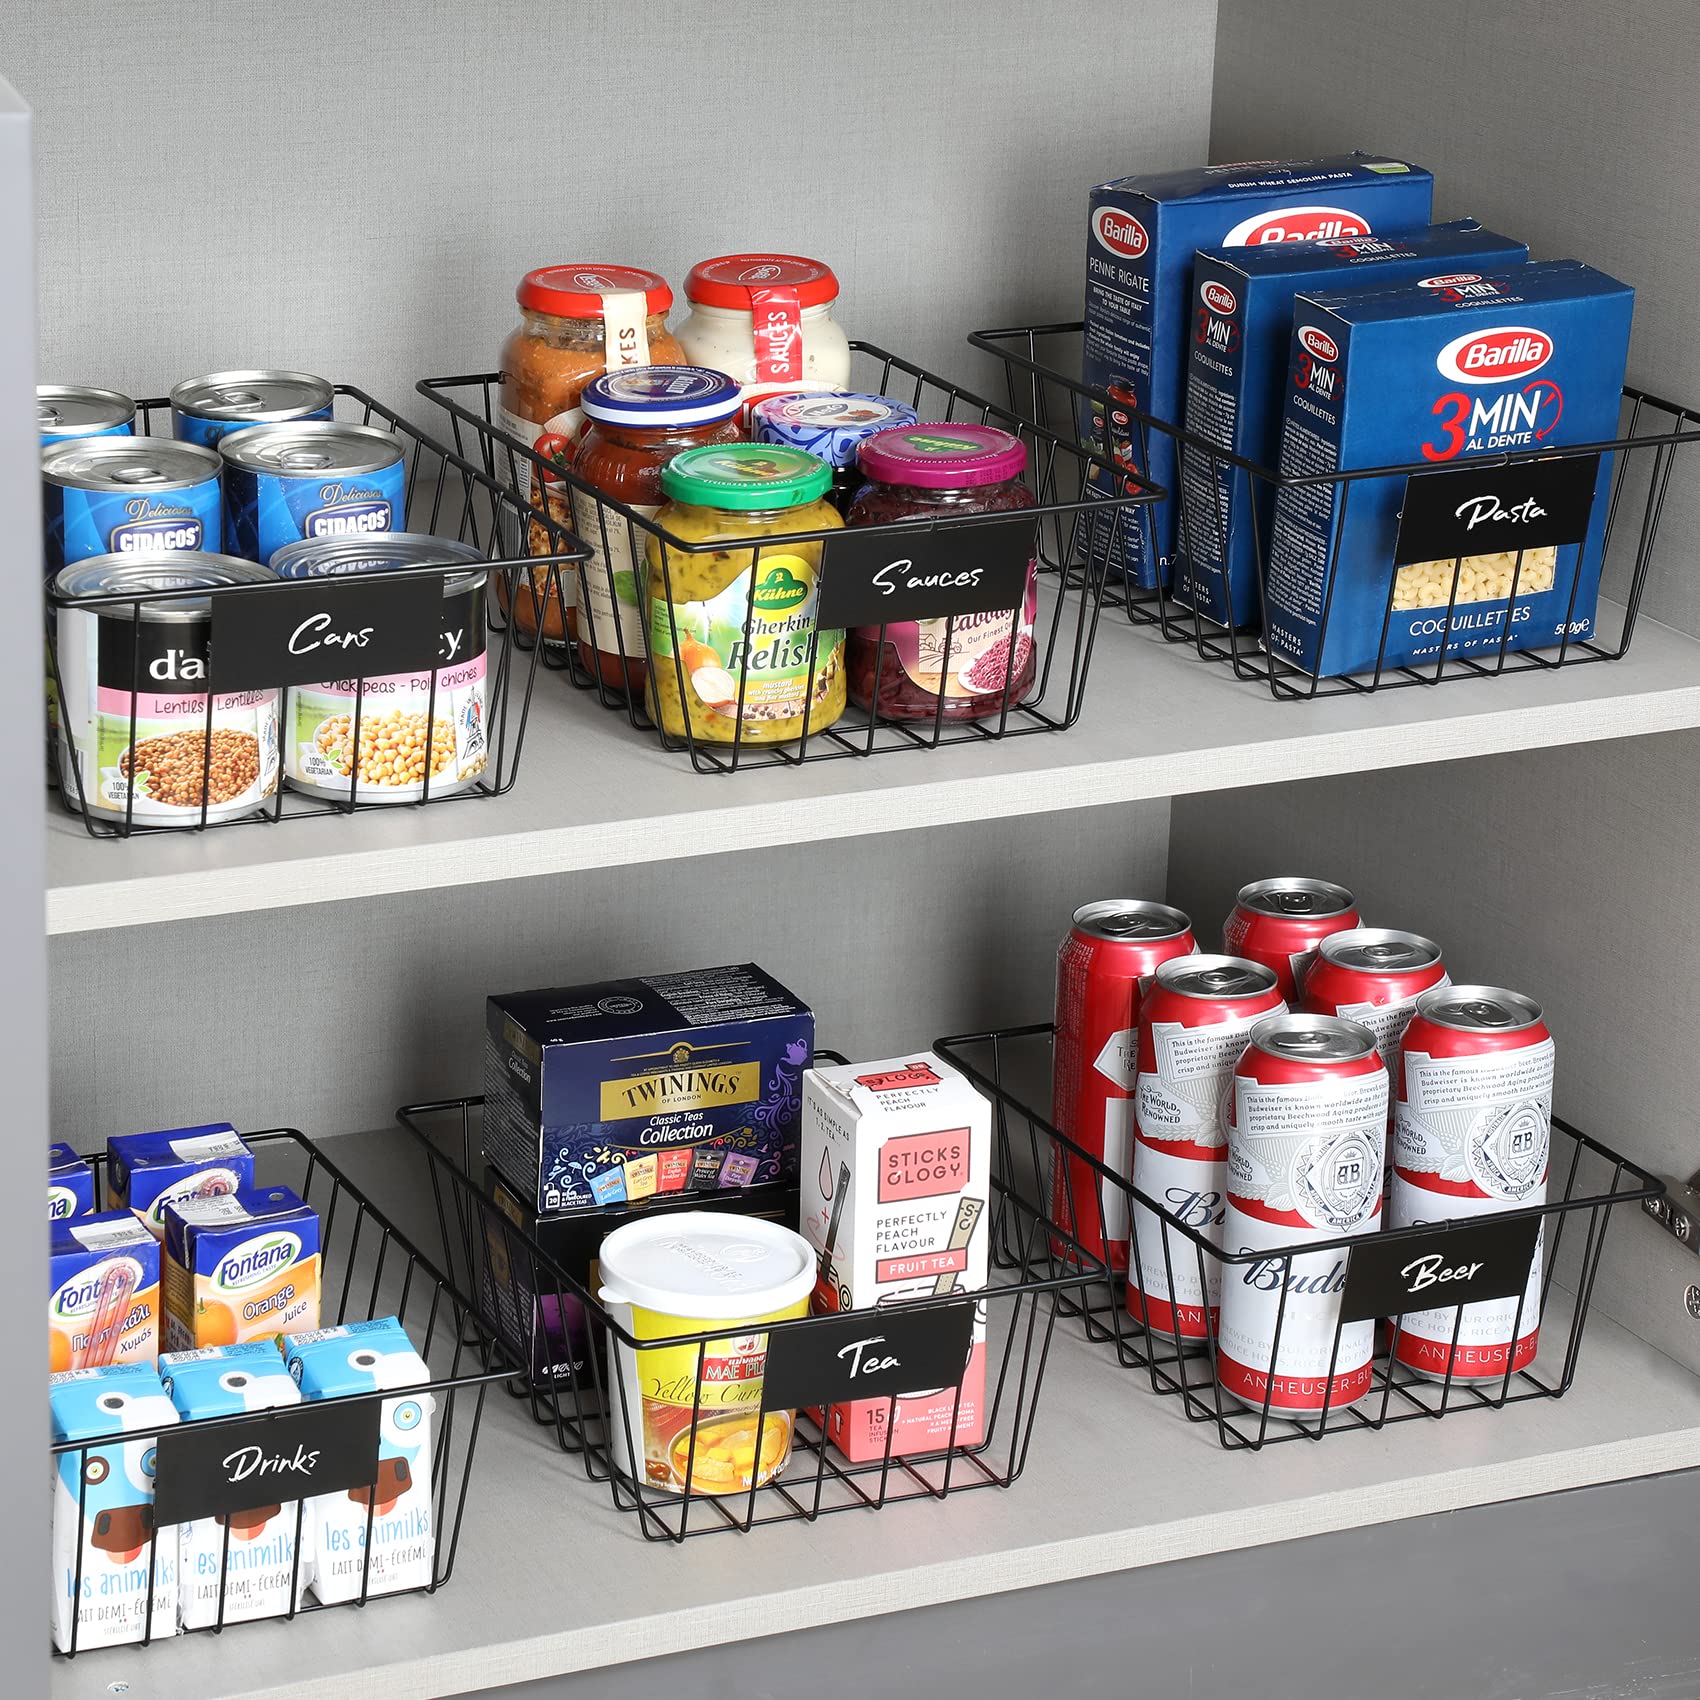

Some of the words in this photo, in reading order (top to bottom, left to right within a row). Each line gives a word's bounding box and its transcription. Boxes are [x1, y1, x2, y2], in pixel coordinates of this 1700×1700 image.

[1228, 181, 1256, 189] DURUM
[1258, 179, 1285, 187] WHEAT
[1287, 175, 1327, 185] SEMOLINA
[1328, 172, 1353, 180] PASTA
[1103, 217, 1143, 249] Barilla
[1350, 242, 1391, 252] MIN
[1089, 257, 1115, 280] PENNE
[1118, 268, 1149, 293] RIGATE
[1208, 288, 1232, 309] Barilla
[1453, 283, 1498, 295] MIN
[1455, 296, 1524, 309] COQUILLETTES
[1195, 307, 1211, 345] 3
[1207, 316, 1231, 345] MIN
[768, 310, 790, 374] SAUCES
[1307, 334, 1335, 357] Barilla
[1194, 350, 1233, 377] COQUILLETTES
[1464, 337, 1544, 369] Barilla
[1295, 352, 1313, 389] 3
[1310, 362, 1336, 392] MIN
[1293, 394, 1336, 426] COQUILLETTES
[1422, 392, 1471, 461] 3
[1469, 390, 1541, 437] MIN
[1466, 438, 1484, 450] AL
[1488, 431, 1532, 448] DENTE
[314, 510, 387, 537] CIDACOS
[1455, 495, 1548, 531] Pasta
[119, 526, 197, 550] CIDACOS
[871, 559, 984, 595] Sauces
[754, 586, 804, 602] Kühne
[288, 612, 377, 655] Cans
[967, 633, 981, 645] Our
[983, 626, 1004, 640] Finest
[1272, 623, 1301, 645] MASTERS
[1280, 637, 1302, 655] PASTA
[1412, 642, 1459, 655] MASTRS
[1464, 639, 1478, 648] OF
[1483, 635, 1514, 645] PASA
[149, 648, 207, 680] d'a
[363, 679, 396, 696] peas
[441, 666, 478, 688] chiches
[305, 766, 333, 776] VEGETARIAN
[1362, 1019, 1377, 1027] This
[1172, 1040, 1185, 1048] This
[1206, 1033, 1233, 1046] famous
[1174, 1046, 1213, 1057] Budweiser
[1226, 1040, 1250, 1048] known
[1175, 1054, 1216, 1065] proprietary
[1177, 1066, 1194, 1074] crisp
[1451, 1068, 1479, 1077] famous
[1533, 1055, 1549, 1064] Brewed
[1421, 1078, 1457, 1087] Budweiser
[1499, 1068, 1535, 1079] worldwide
[1422, 1086, 1461, 1095] proprietary
[1463, 1082, 1506, 1091] Beechwood
[1507, 1078, 1526, 1087] Aging
[622, 1072, 740, 1108] TWININGS
[673, 1094, 702, 1103] LONDON
[876, 1087, 939, 1100] PERFECTLY
[1247, 1096, 1258, 1104] This
[1276, 1095, 1303, 1104] famous
[1424, 1097, 1440, 1105] crisp
[1441, 1095, 1455, 1103] and
[1456, 1092, 1490, 1102] uniquely
[1492, 1087, 1518, 1098] smooth
[1519, 1084, 1535, 1092] taste
[880, 1098, 911, 1107] PEACH
[884, 1102, 927, 1113] FLAVOUR
[1141, 1102, 1180, 1123] RENOWNED
[1150, 1094, 1177, 1111] WORLD
[1294, 1101, 1321, 1110] known
[1324, 1097, 1362, 1108] worldwide
[650, 1114, 681, 1126] Classic
[684, 1112, 703, 1122] Teas
[807, 1096, 816, 1110] IT'S
[816, 1105, 823, 1117] AS
[823, 1111, 842, 1133] SIMPLE
[842, 1129, 850, 1141] AS
[1249, 1114, 1285, 1123] proprietary
[1288, 1111, 1331, 1119] Beechwood
[1332, 1108, 1353, 1116] Aging
[1354, 1104, 1379, 1114] produces
[1281, 1121, 1315, 1130] uniquely
[1317, 1118, 1344, 1127] smooth
[1345, 1115, 1361, 1123] taste
[1362, 1112, 1374, 1120] with
[640, 1123, 714, 1145] Collection
[1511, 1132, 1533, 1154] AB
[888, 1146, 961, 1168] STICKS
[887, 1163, 961, 1185] OLOGY
[1337, 1163, 1360, 1185] AB
[1505, 1181, 1534, 1193] AMERICA
[877, 1211, 947, 1228] PERFECTLY
[1330, 1214, 1361, 1225] AMERICA
[877, 1227, 918, 1241] PEACH
[877, 1237, 935, 1253] FLAVOUR
[220, 1243, 293, 1287] Fontana
[261, 1264, 277, 1274] TASTE
[889, 1260, 927, 1275] FRUIT
[932, 1256, 955, 1268] TEA
[1400, 1254, 1484, 1293] Beer
[242, 1283, 295, 1321] Orange
[283, 1301, 307, 1325] Juice
[837, 1335, 901, 1379] Tea
[706, 1364, 740, 1379] MAE
[866, 1408, 884, 1424] 15
[907, 1416, 932, 1424] NATURAL
[928, 1406, 947, 1414] BLACK
[222, 1443, 321, 1484] Drinks
[325, 1521, 350, 1551] les
[226, 1535, 298, 1573] animilk
[332, 1560, 353, 1576] LAIT
[357, 1544, 427, 1573] DMI-ÉCRÉMÉ
[100, 1559, 175, 1596] animlks
[198, 1585, 218, 1600] LAIT
[223, 1571, 291, 1597] DEMI-ÉCRÉM
